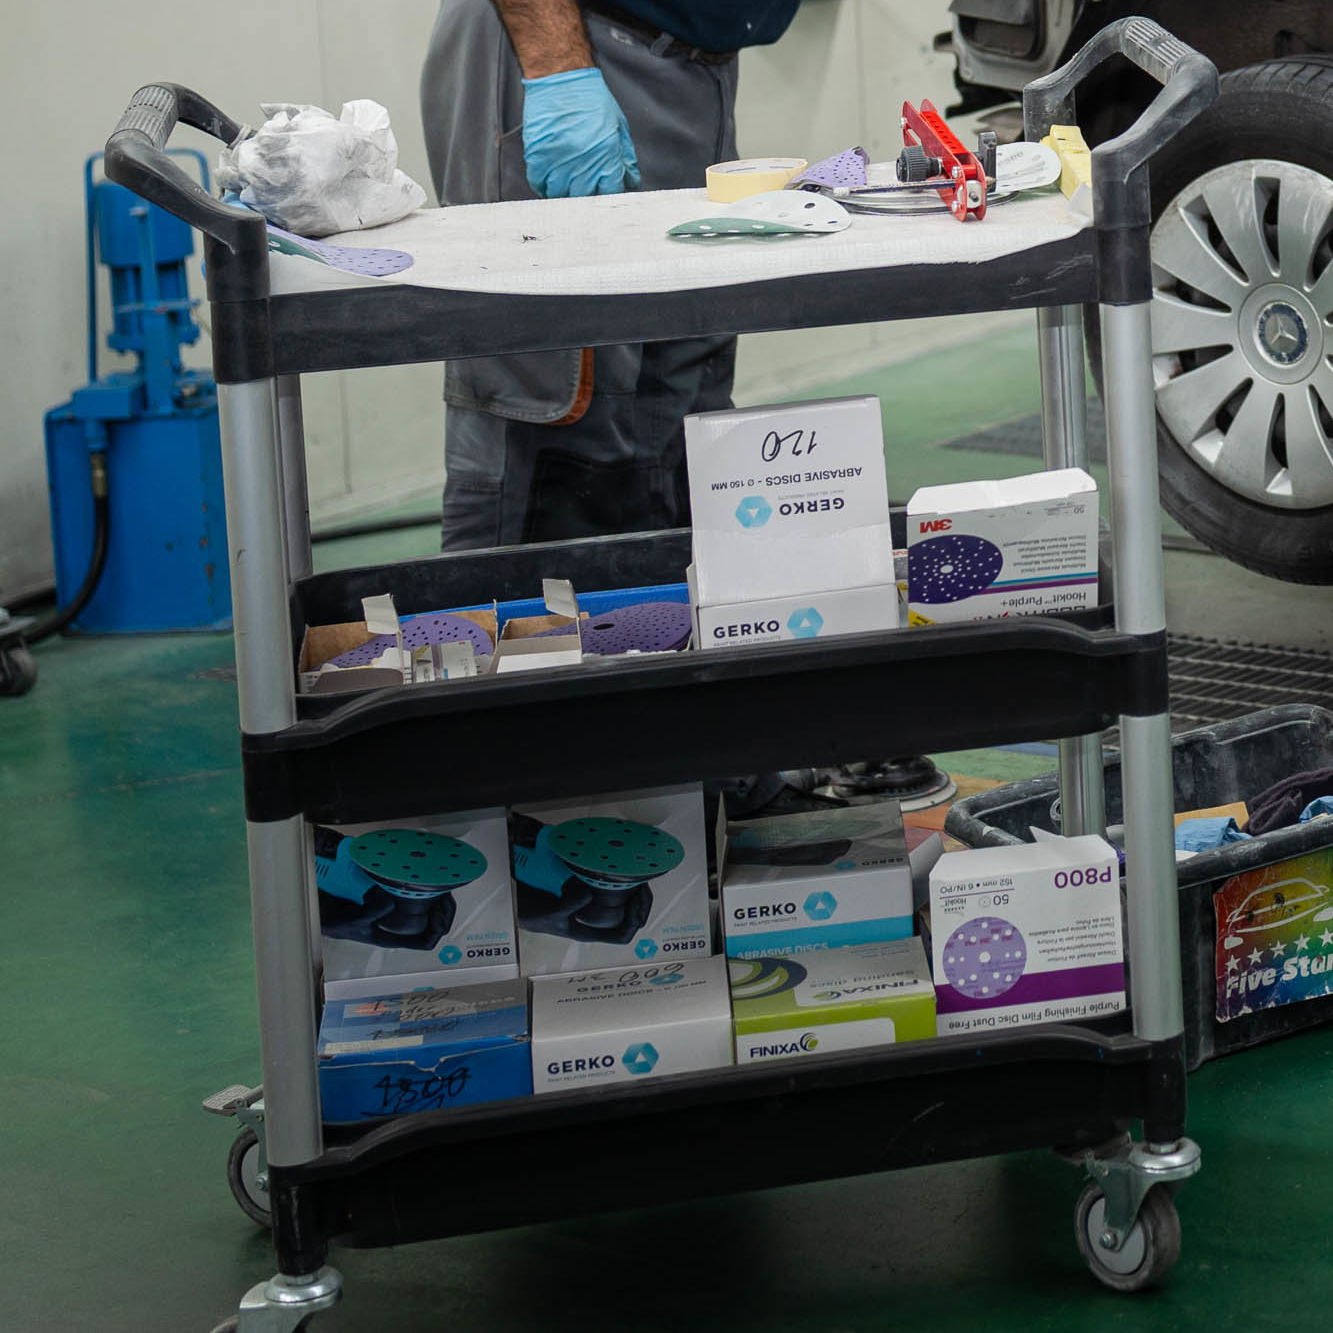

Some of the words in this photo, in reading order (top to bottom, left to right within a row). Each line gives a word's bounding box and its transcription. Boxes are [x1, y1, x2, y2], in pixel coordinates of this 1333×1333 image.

[762, 430, 818, 462] 120
[765, 471, 801, 486] DISCS
[804, 466, 863, 482] ABRASIVE
[711, 482, 728, 491] MM
[728, 479, 746, 489] 150
[778, 496, 845, 516] GERKO
[919, 518, 953, 533] 3M
[1000, 594, 1043, 608] Purple+
[713, 619, 780, 639] GERKO
[982, 880, 998, 888] mm
[999, 878, 1013, 888] 152
[1054, 866, 1112, 889] P800
[940, 884, 967, 894] IN/PO
[993, 894, 1009, 905] 50
[734, 902, 797, 920] GERKO
[466, 946, 510, 959] GERKO
[662, 939, 706, 952] GERKO
[737, 945, 793, 960] ABRASIVE
[576, 980, 642, 993] GERKO
[842, 979, 919, 995] FINIXA
[1226, 969, 1276, 999] Five
[1044, 1004, 1087, 1018] Finishing
[1089, 1000, 1120, 1012] Purple
[973, 1017, 995, 1027] Dust
[998, 1014, 1019, 1025] Disc
[1021, 1011, 1042, 1022] Film
[948, 1021, 970, 1030] Free
[750, 1041, 800, 1058] FINIXA
[547, 1054, 615, 1074] GERKO
